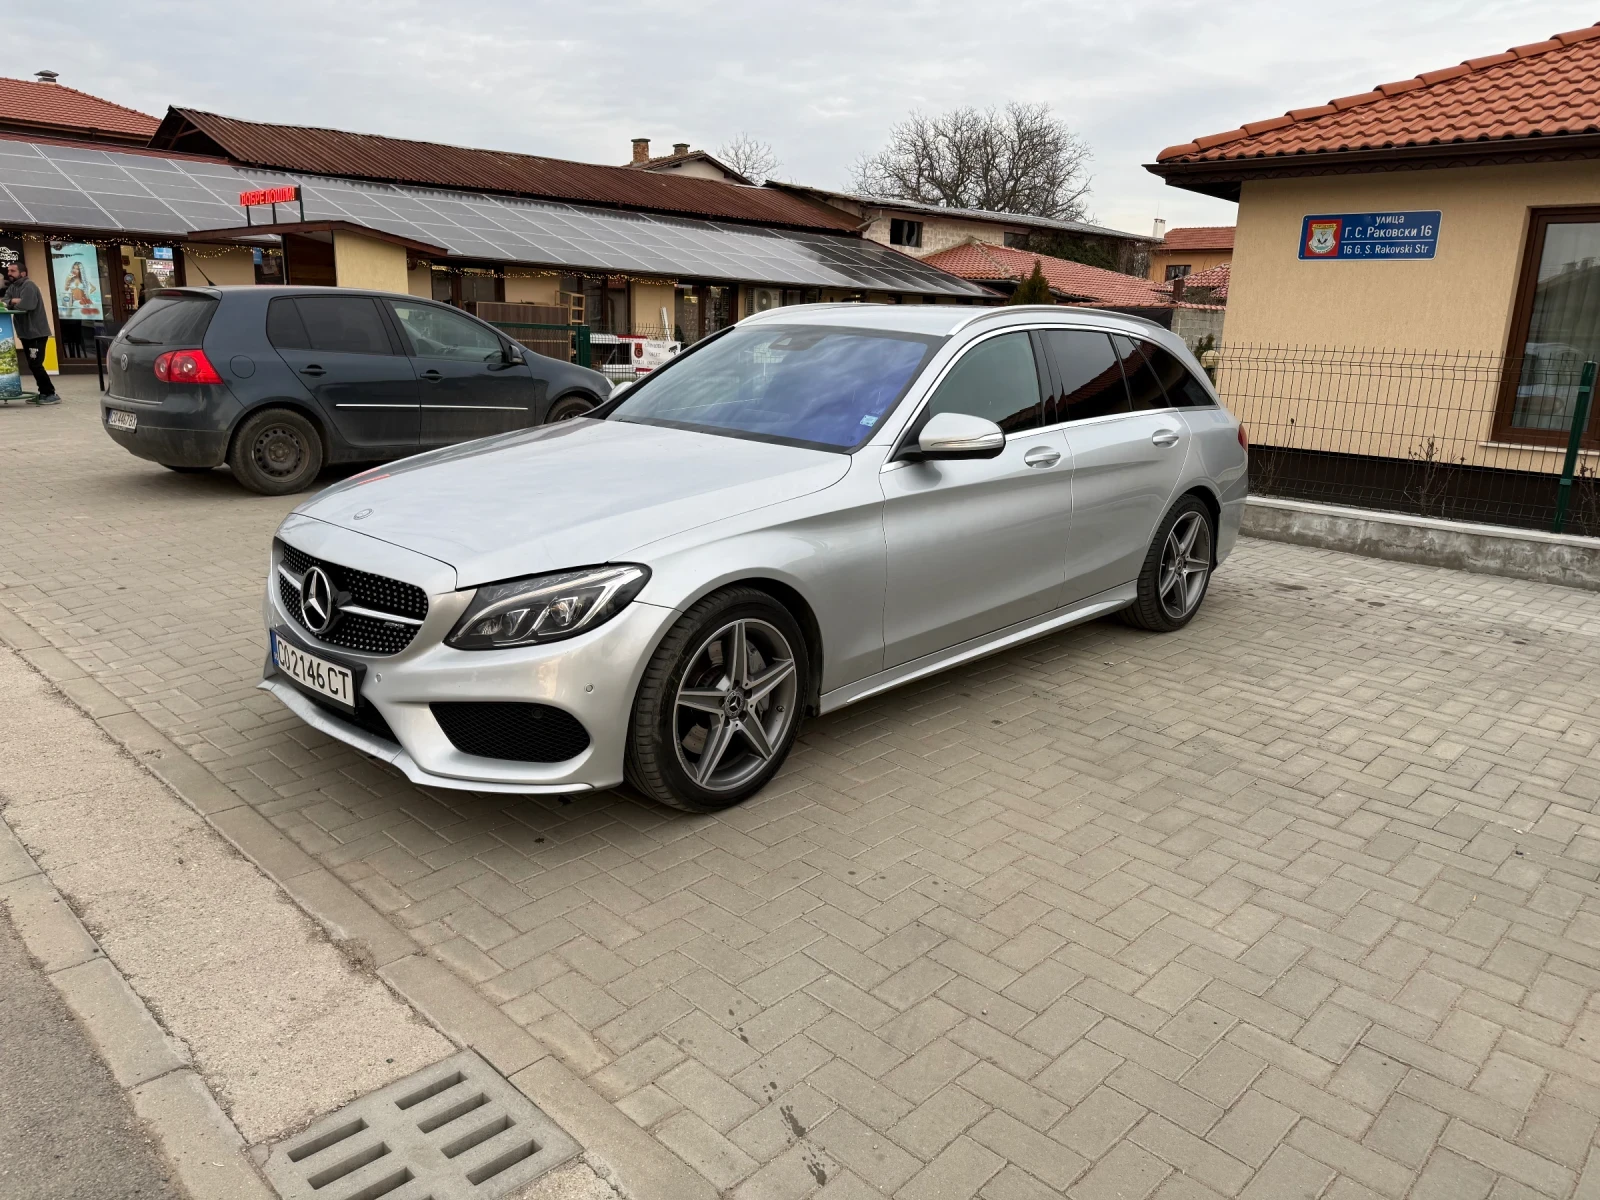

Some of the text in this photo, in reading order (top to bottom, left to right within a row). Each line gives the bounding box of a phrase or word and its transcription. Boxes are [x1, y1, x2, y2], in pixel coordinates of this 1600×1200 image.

[1375, 215, 1405, 227] улица
[1367, 226, 1417, 238] Раковски
[1420, 225, 1432, 237] 16
[1343, 245, 1352, 254] 16
[1354, 245, 1363, 254] G.
[1365, 245, 1373, 254] S.
[1375, 244, 1413, 254] Rakovski
[1415, 244, 1429, 254] Str
